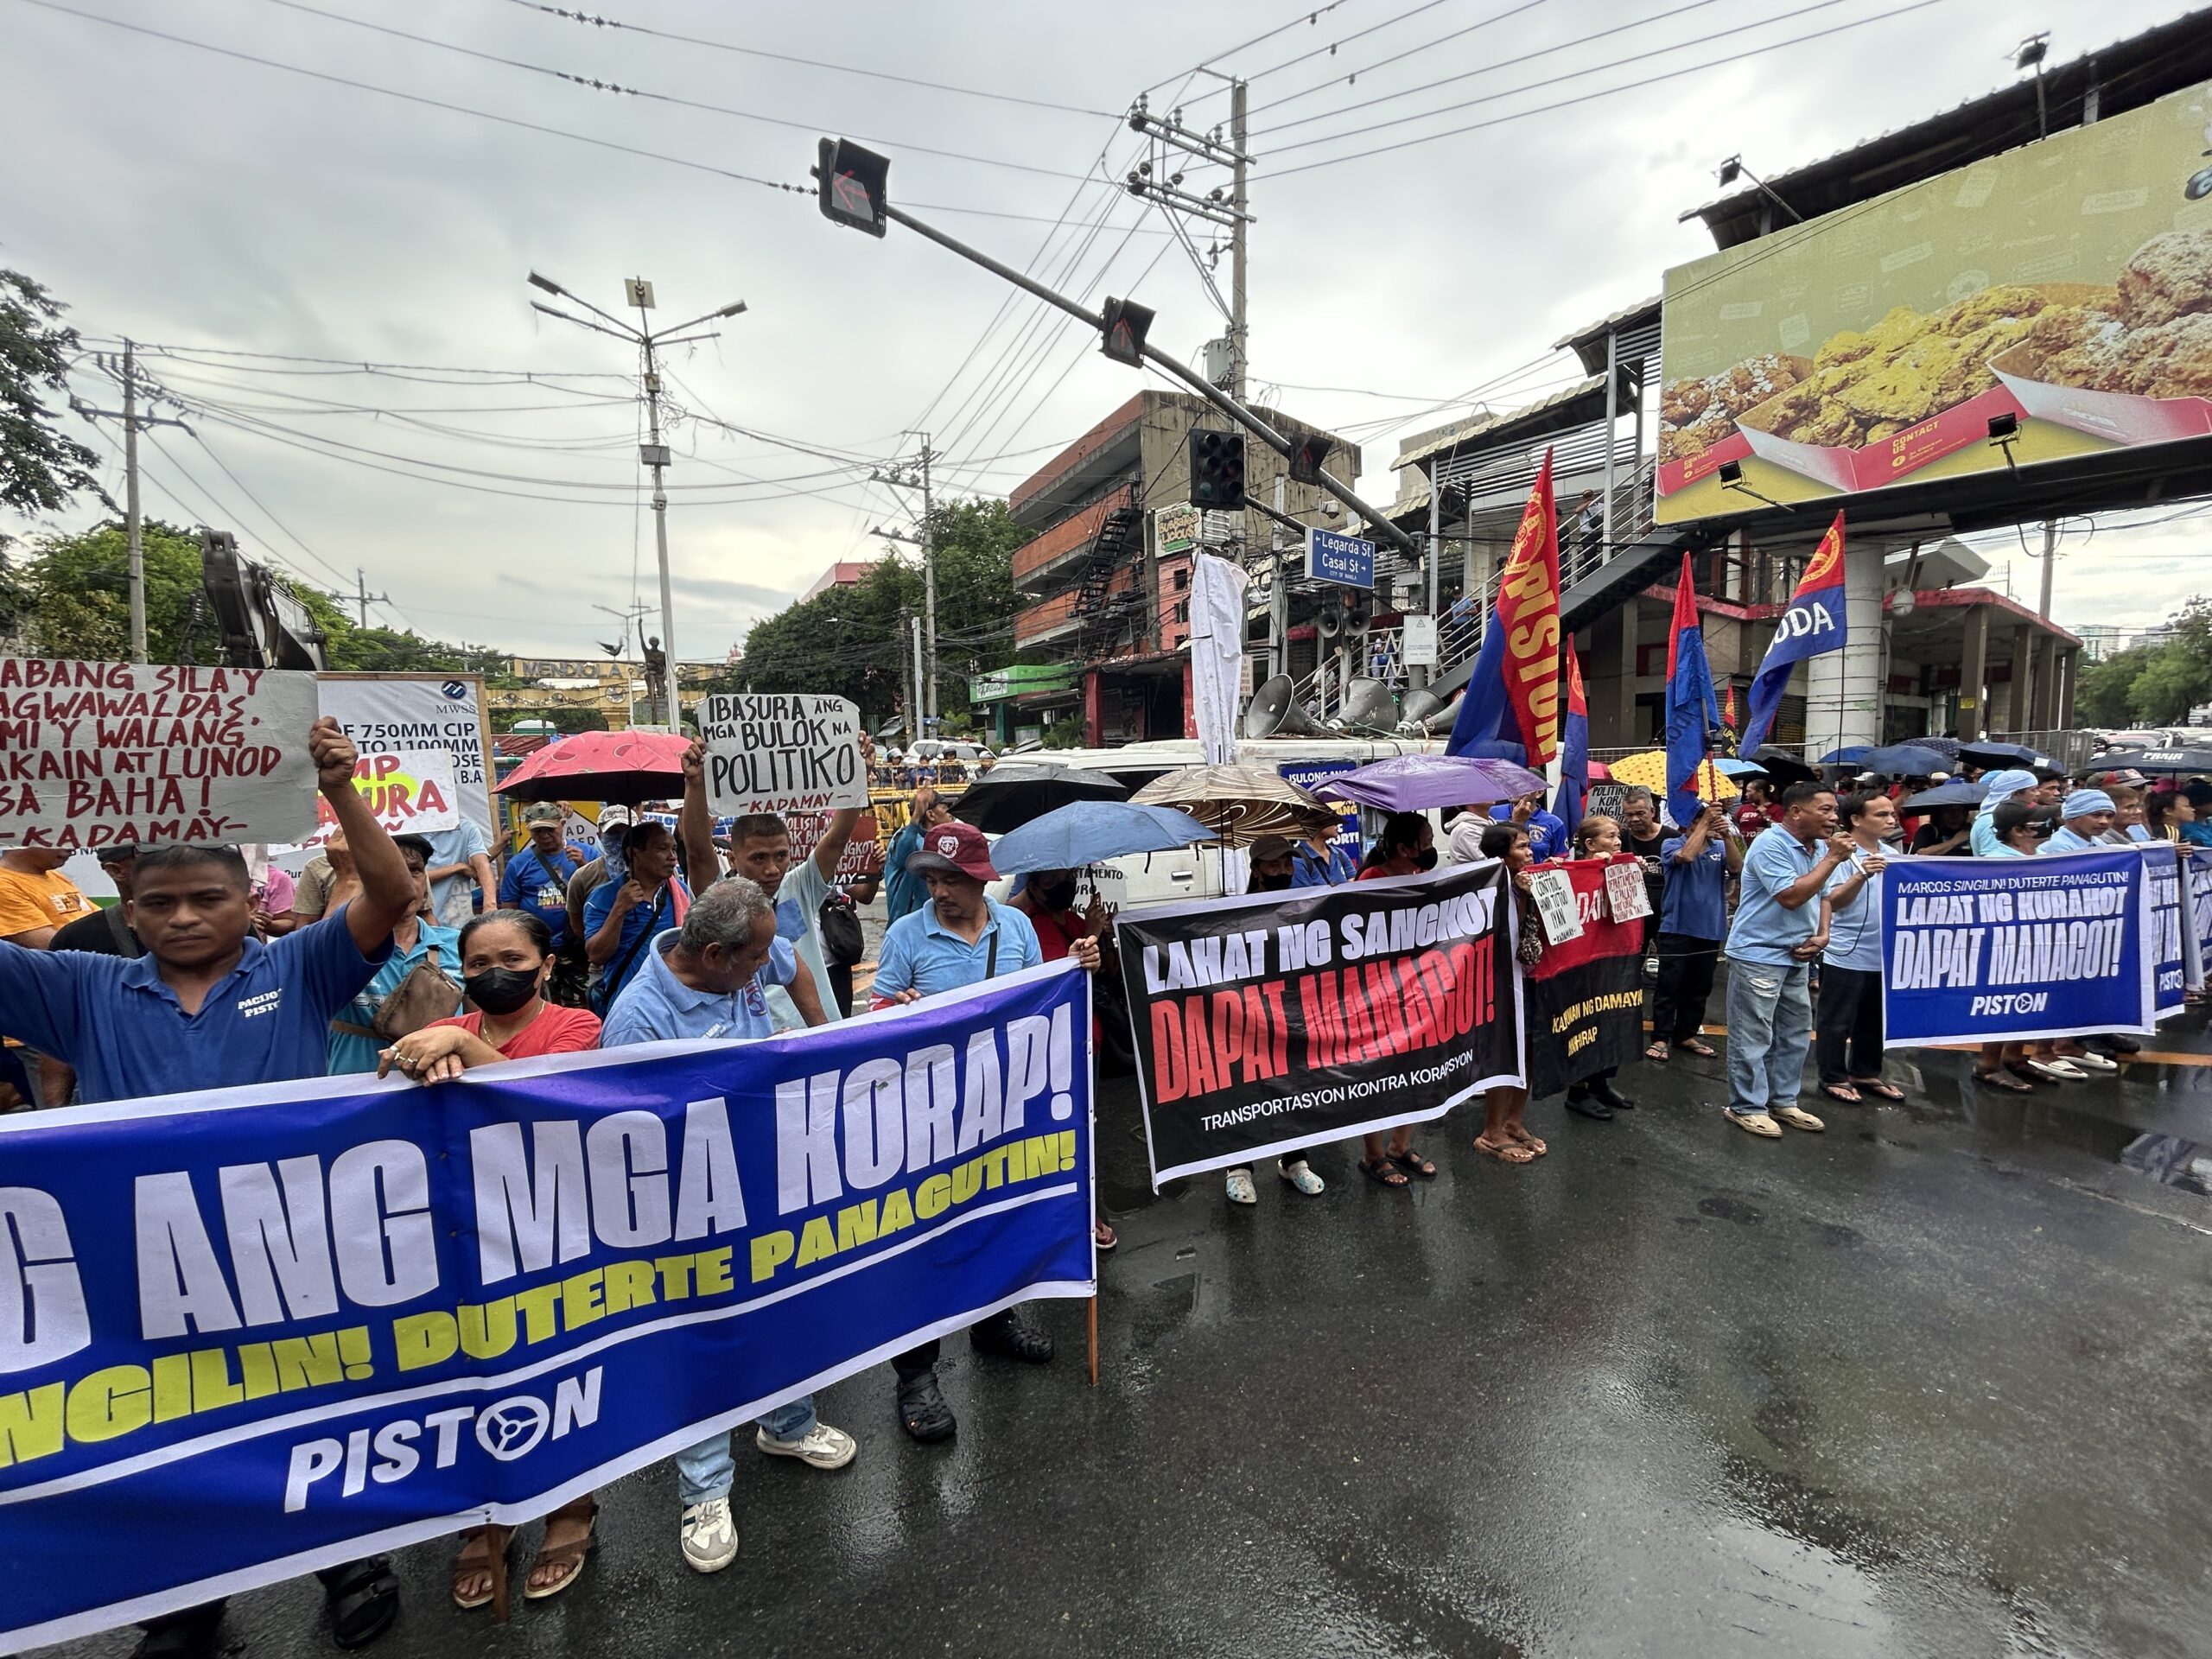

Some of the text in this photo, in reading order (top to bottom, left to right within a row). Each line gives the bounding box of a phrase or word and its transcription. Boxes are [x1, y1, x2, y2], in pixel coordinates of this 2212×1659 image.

[1892, 421, 1940, 447] CONTACT
[1892, 443, 1907, 454] US
[1322, 533, 1371, 558] Legarda St
[1322, 553, 1359, 573] Casal St
[1764, 601, 1836, 658] ODA
[1, 659, 264, 696] ABANG SILA'Y
[522, 662, 624, 678] MENDIOLA
[435, 704, 476, 715] MWSS
[709, 696, 843, 723] IBASURA ANG
[96, 718, 245, 749] WALANG
[360, 723, 439, 738] 750MM
[443, 722, 475, 737] CIP
[702, 718, 852, 752] MGA BULOK NA
[357, 738, 479, 754] TO 1100MM
[0, 745, 282, 781] KAIN AT LUNOD
[711, 742, 855, 798] POLITIKO
[0, 782, 41, 817] SA
[1325, 831, 1360, 846] ORT!
[1076, 868, 1123, 880] TAMENTO
[1897, 871, 2130, 894] MARCOS SINGILIN! DUTERTE PANAGUTIN!
[1896, 886, 2128, 926] LAHAT NG KURAKOT
[1142, 886, 1497, 995] LAHAT NG SANGKOT
[1891, 917, 2125, 990] DAPAT MANAGOT!
[1149, 933, 1496, 1104] DAPAT MANAGOT!
[1582, 998, 1594, 1017] NG
[1969, 992, 2048, 1016] PISTON
[1201, 1048, 1474, 1131] TRANSPORTASYON KONTRA KORAPSYON
[135, 1139, 440, 1340] ANG
[469, 1096, 747, 1286] MGA
[775, 1001, 1072, 1216] KORAP!
[393, 1246, 734, 1371] DUTERTE
[750, 1129, 1077, 1284] PANAGUTIN!
[283, 1365, 603, 1513] PISTON
